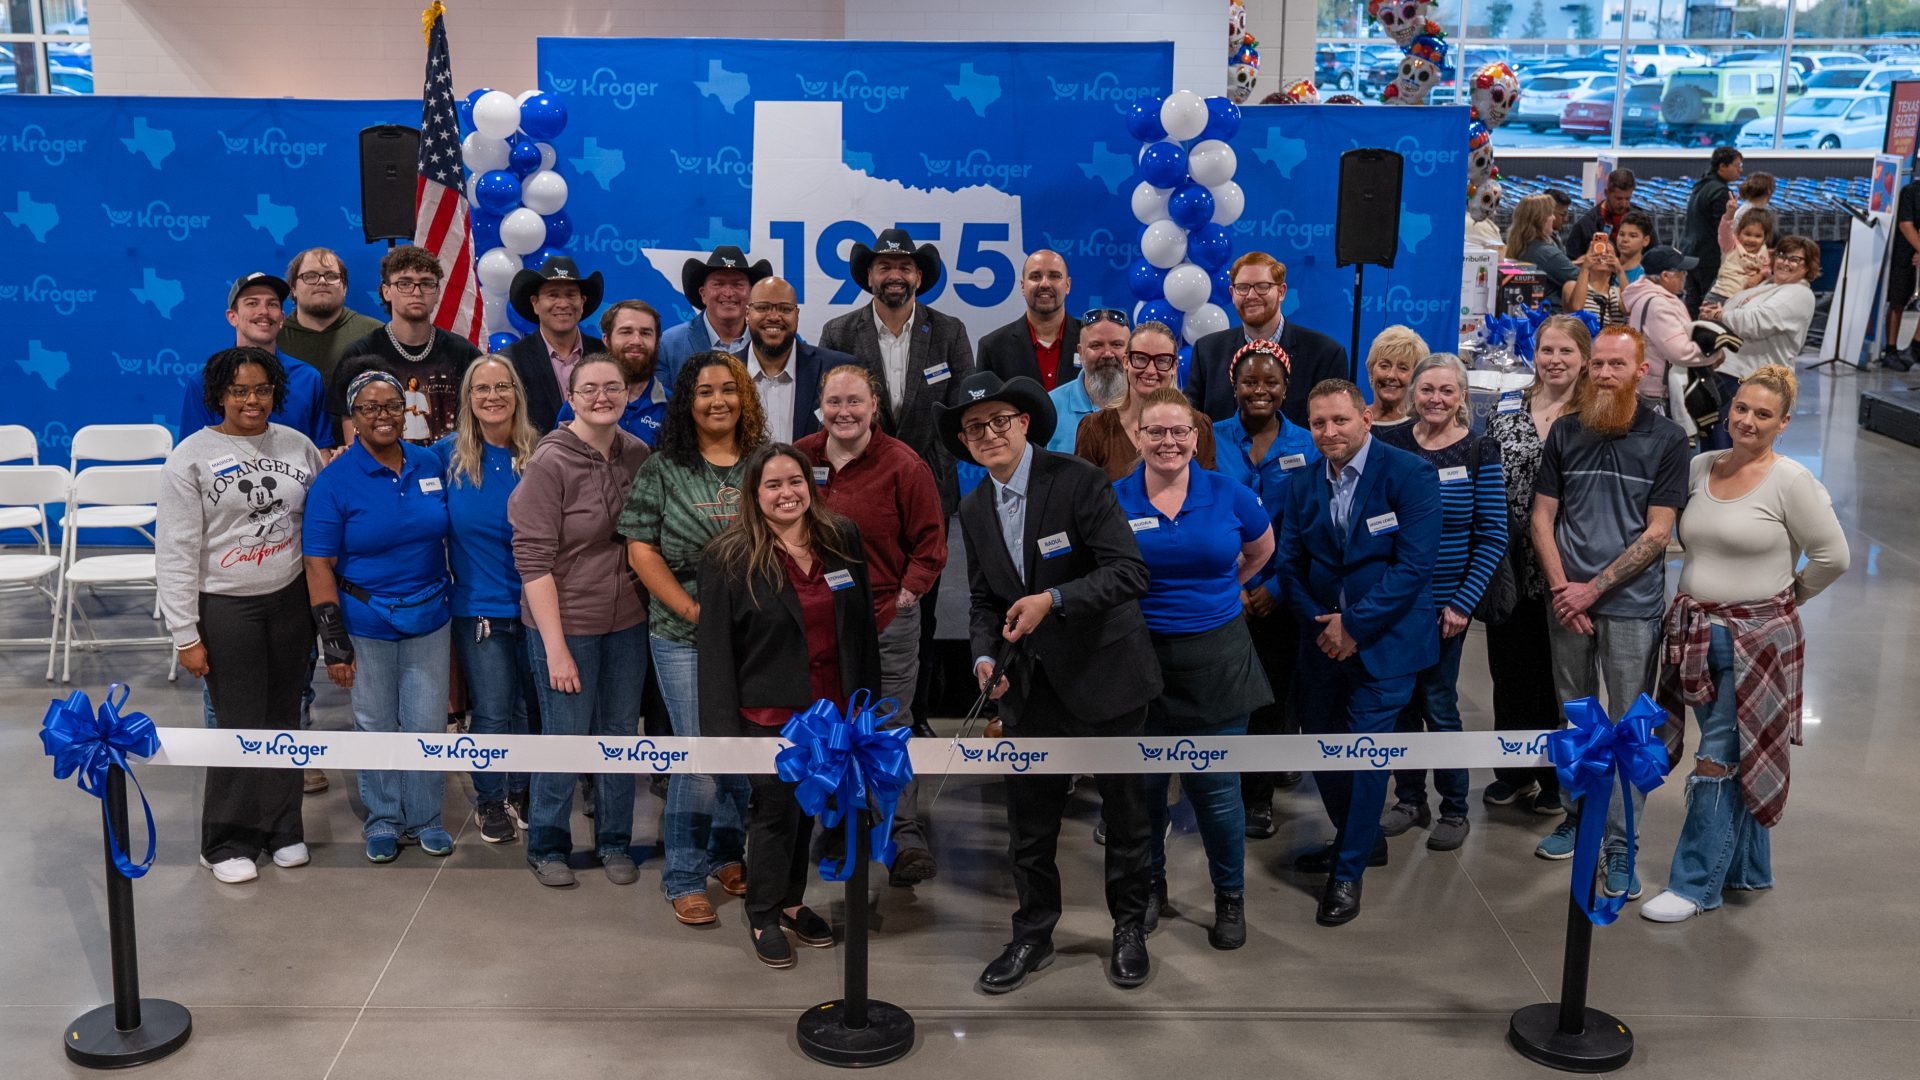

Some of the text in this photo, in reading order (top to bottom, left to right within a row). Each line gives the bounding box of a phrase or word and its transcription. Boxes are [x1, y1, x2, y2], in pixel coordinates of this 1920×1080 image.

[582, 67, 658, 110] Kroger
[833, 70, 909, 113] Kroger
[1084, 72, 1160, 114] Kroger
[1898, 101, 1919, 113] TEXAS
[1896, 114, 1917, 127] SIZED
[13, 124, 87, 166] Kroger
[253, 127, 327, 168] Kroger
[955, 149, 1032, 190] Kroger
[138, 200, 210, 241] Kroger
[1261, 209, 1334, 250] Kroger
[584, 224, 660, 265] Kroger
[1079, 228, 1142, 270] Kroge
[23, 275, 97, 315] Kroger
[1377, 285, 1450, 326] Kroger
[207, 458, 306, 507] LOS ANGELE
[266, 733, 328, 766] Kroger
[447, 737, 508, 769] Kroger
[628, 740, 688, 772] Kroger
[987, 741, 1048, 772] Kroger
[1167, 739, 1228, 771] Kroger
[1346, 736, 1408, 768] Kroger
